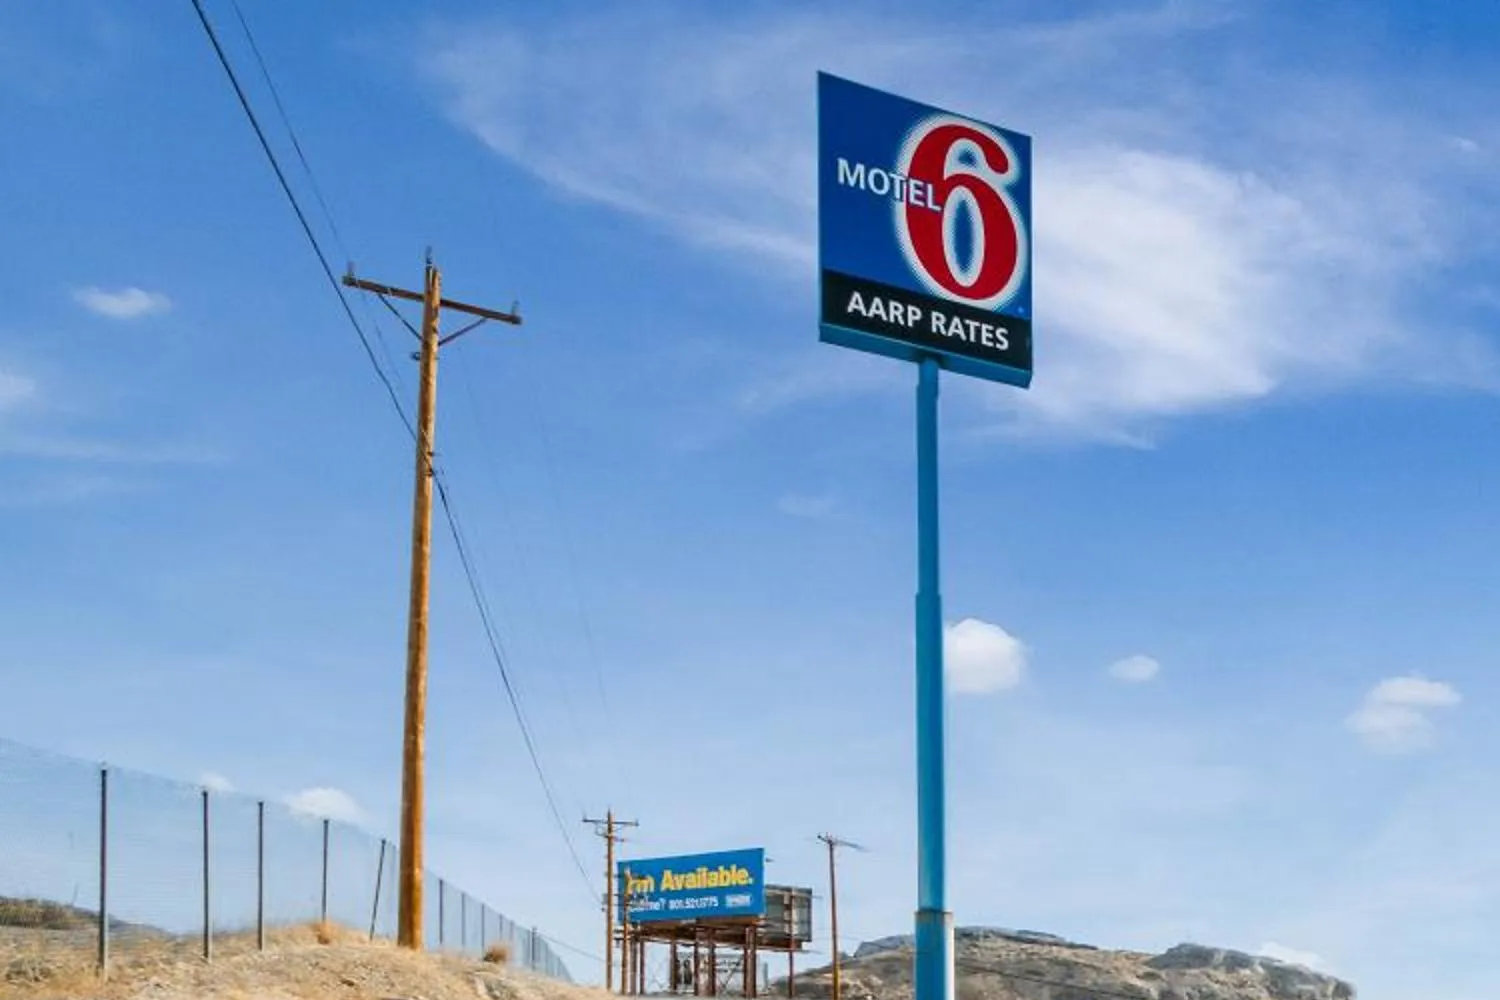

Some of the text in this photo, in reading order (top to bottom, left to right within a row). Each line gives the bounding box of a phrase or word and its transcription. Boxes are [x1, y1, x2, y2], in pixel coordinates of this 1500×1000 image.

[837, 121, 1021, 303] MOTEL 6
[847, 290, 1010, 351] AARP RATES
